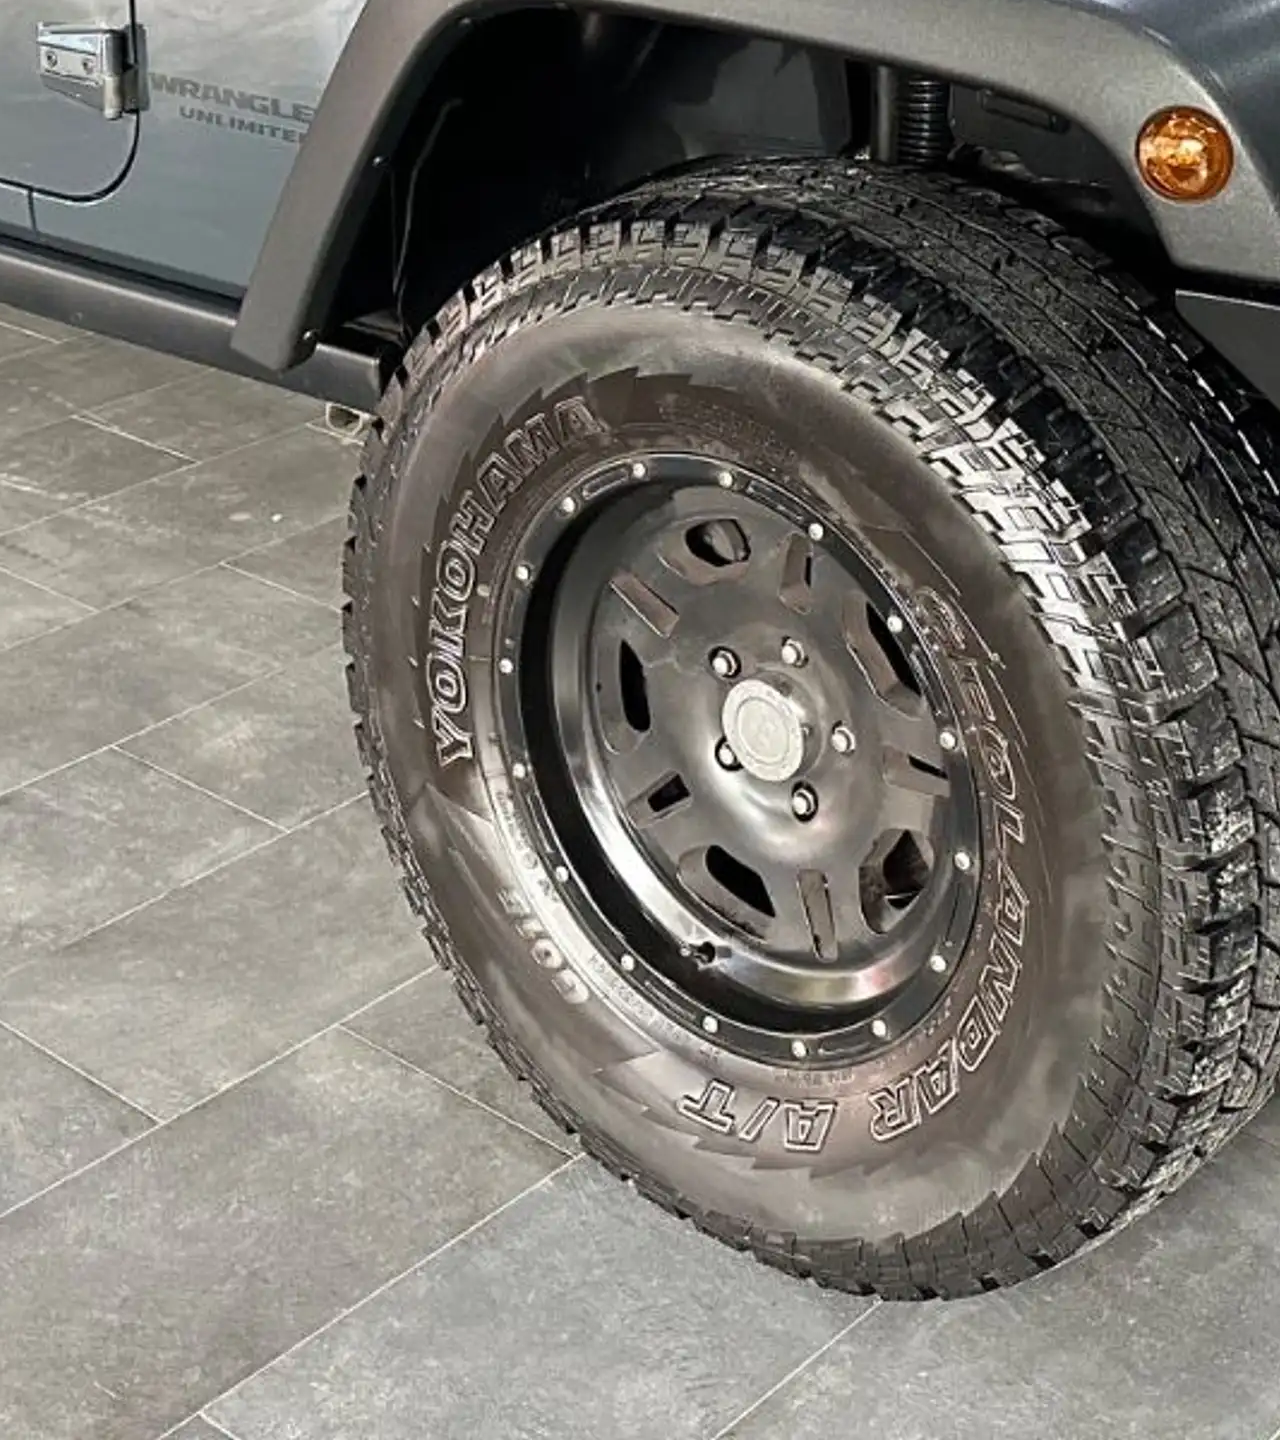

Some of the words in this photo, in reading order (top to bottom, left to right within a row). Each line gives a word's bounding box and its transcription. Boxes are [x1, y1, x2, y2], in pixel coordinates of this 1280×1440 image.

[150, 72, 317, 123] WRANGLE
[179, 106, 304, 143] UNLIMITE
[425, 395, 609, 768] YOKOHAMA
[869, 585, 1031, 1143] GEOLANDAR
[677, 1077, 837, 1152] A/T
